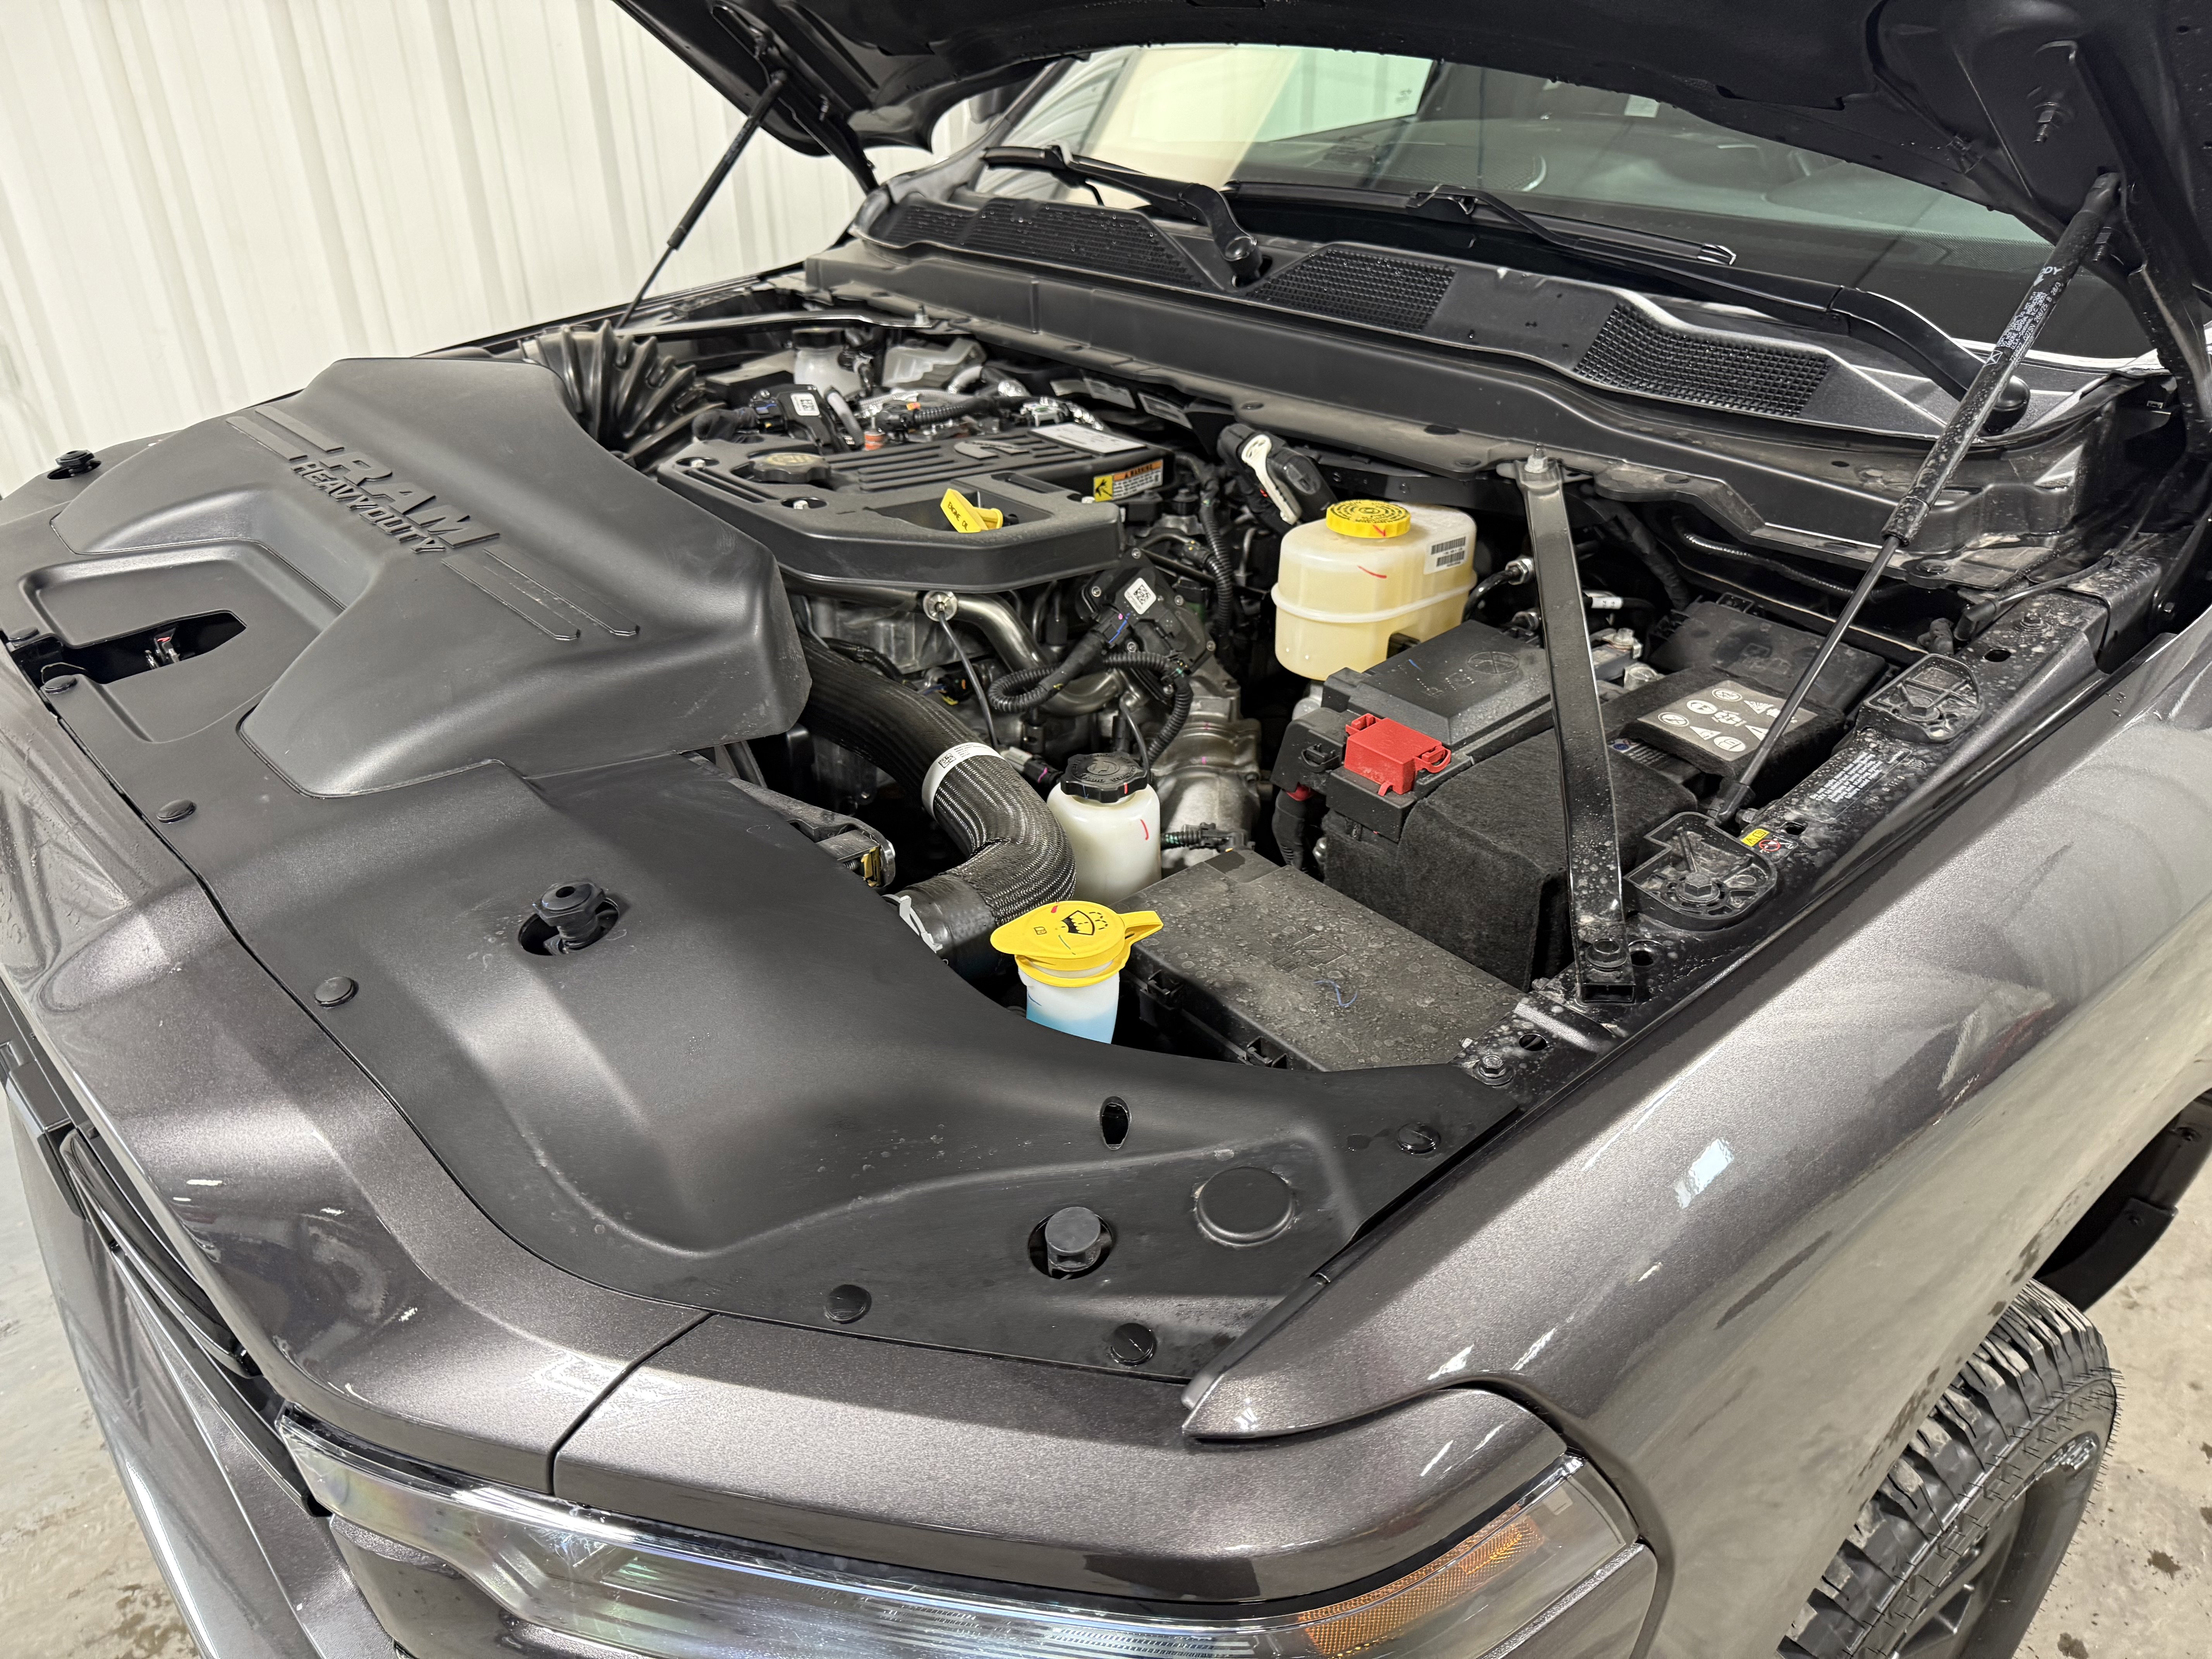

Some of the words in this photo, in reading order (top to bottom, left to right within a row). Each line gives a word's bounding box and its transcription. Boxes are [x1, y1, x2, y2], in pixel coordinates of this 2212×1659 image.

[290, 462, 379, 510] HEAVY
[359, 506, 446, 554] DUTY
[318, 452, 500, 548] RAM
